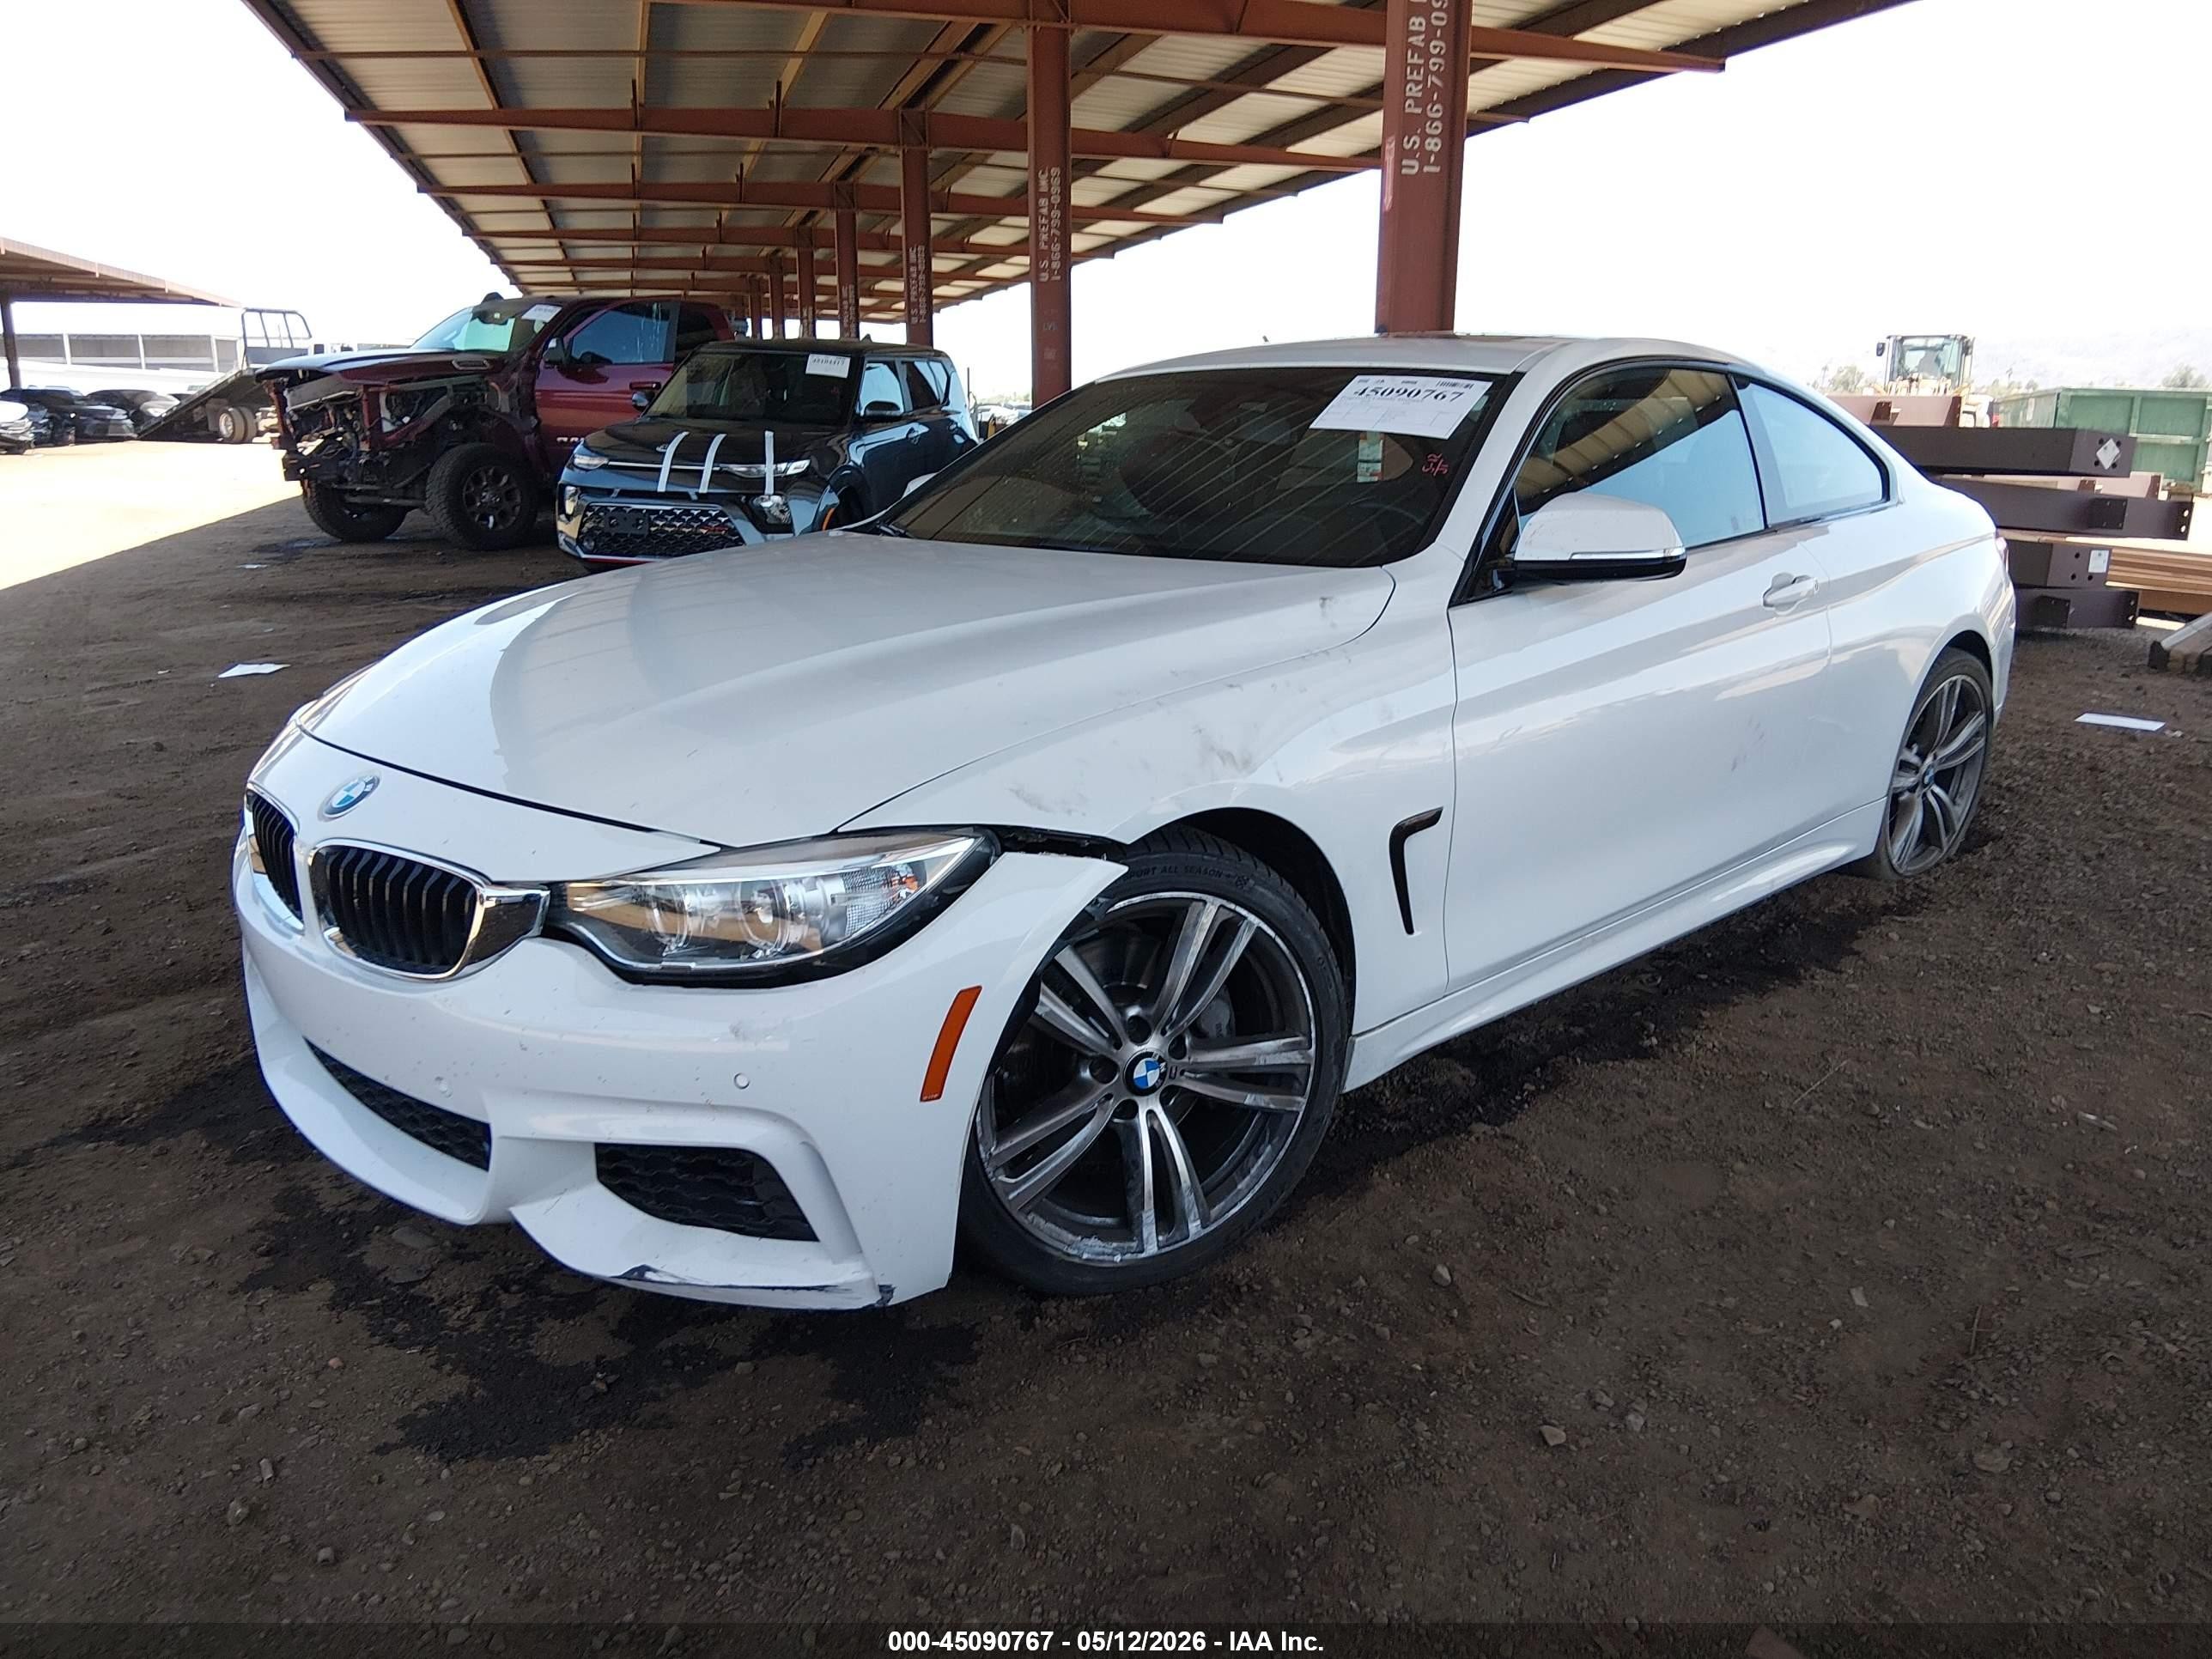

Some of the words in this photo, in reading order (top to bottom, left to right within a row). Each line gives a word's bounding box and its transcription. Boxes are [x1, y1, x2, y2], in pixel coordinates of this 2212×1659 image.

[1405, 16, 1426, 113] PREFAB
[1401, 128, 1421, 174] U.S.
[1038, 198, 1048, 250] PREFAB
[1354, 386, 1464, 403] 45090767
[1161, 865, 1179, 874] ALL
[1184, 865, 1223, 878] SEASON
